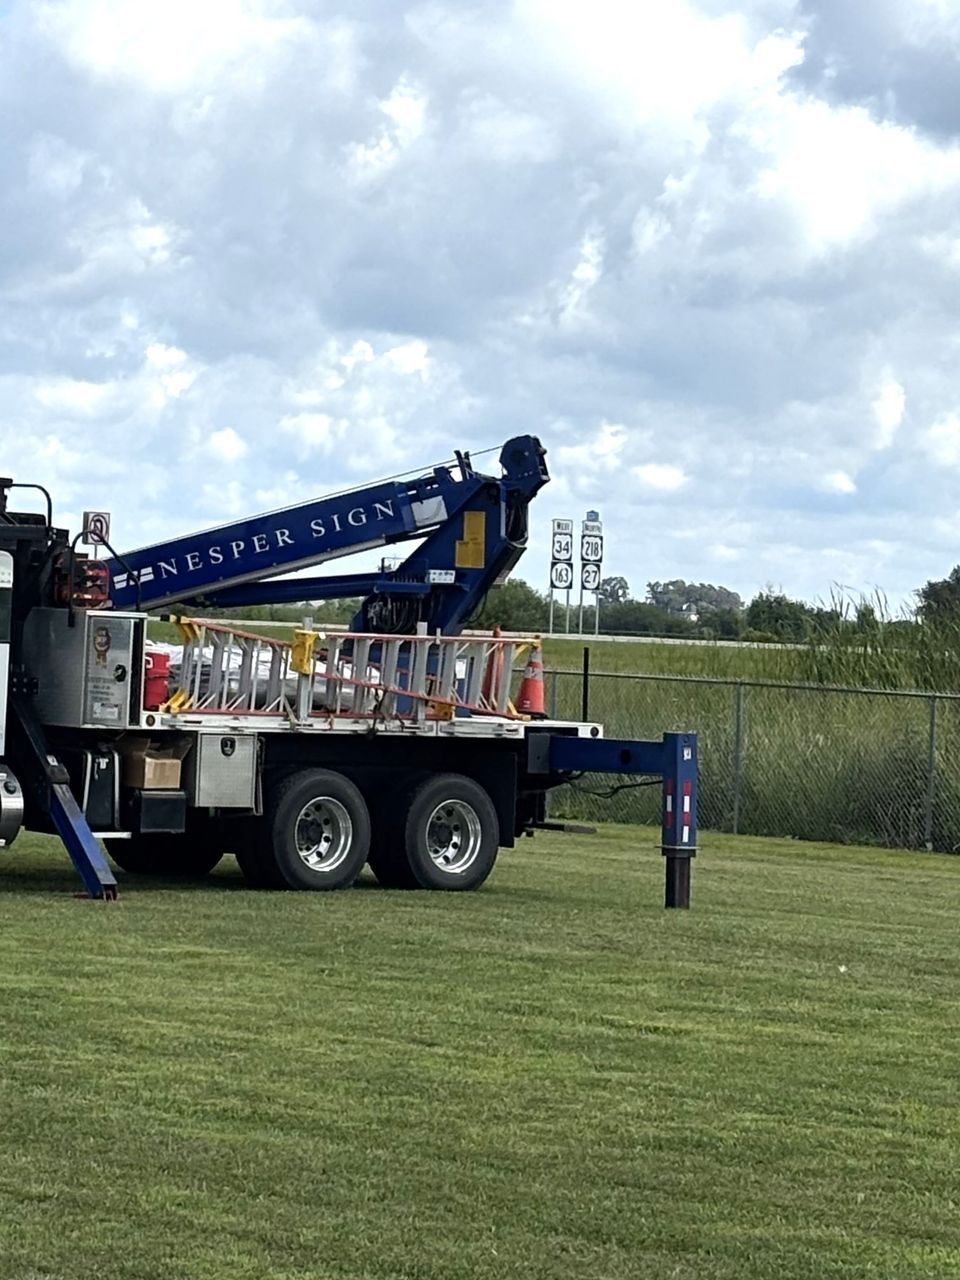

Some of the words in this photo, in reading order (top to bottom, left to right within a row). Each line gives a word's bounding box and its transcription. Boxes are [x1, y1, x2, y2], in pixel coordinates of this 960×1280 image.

[157, 528, 295, 579] NESPER
[310, 499, 397, 538] SIGN
[555, 540, 570, 555] 34
[585, 541, 600, 557] 218
[555, 567, 569, 583] 163
[584, 569, 598, 584] 27
